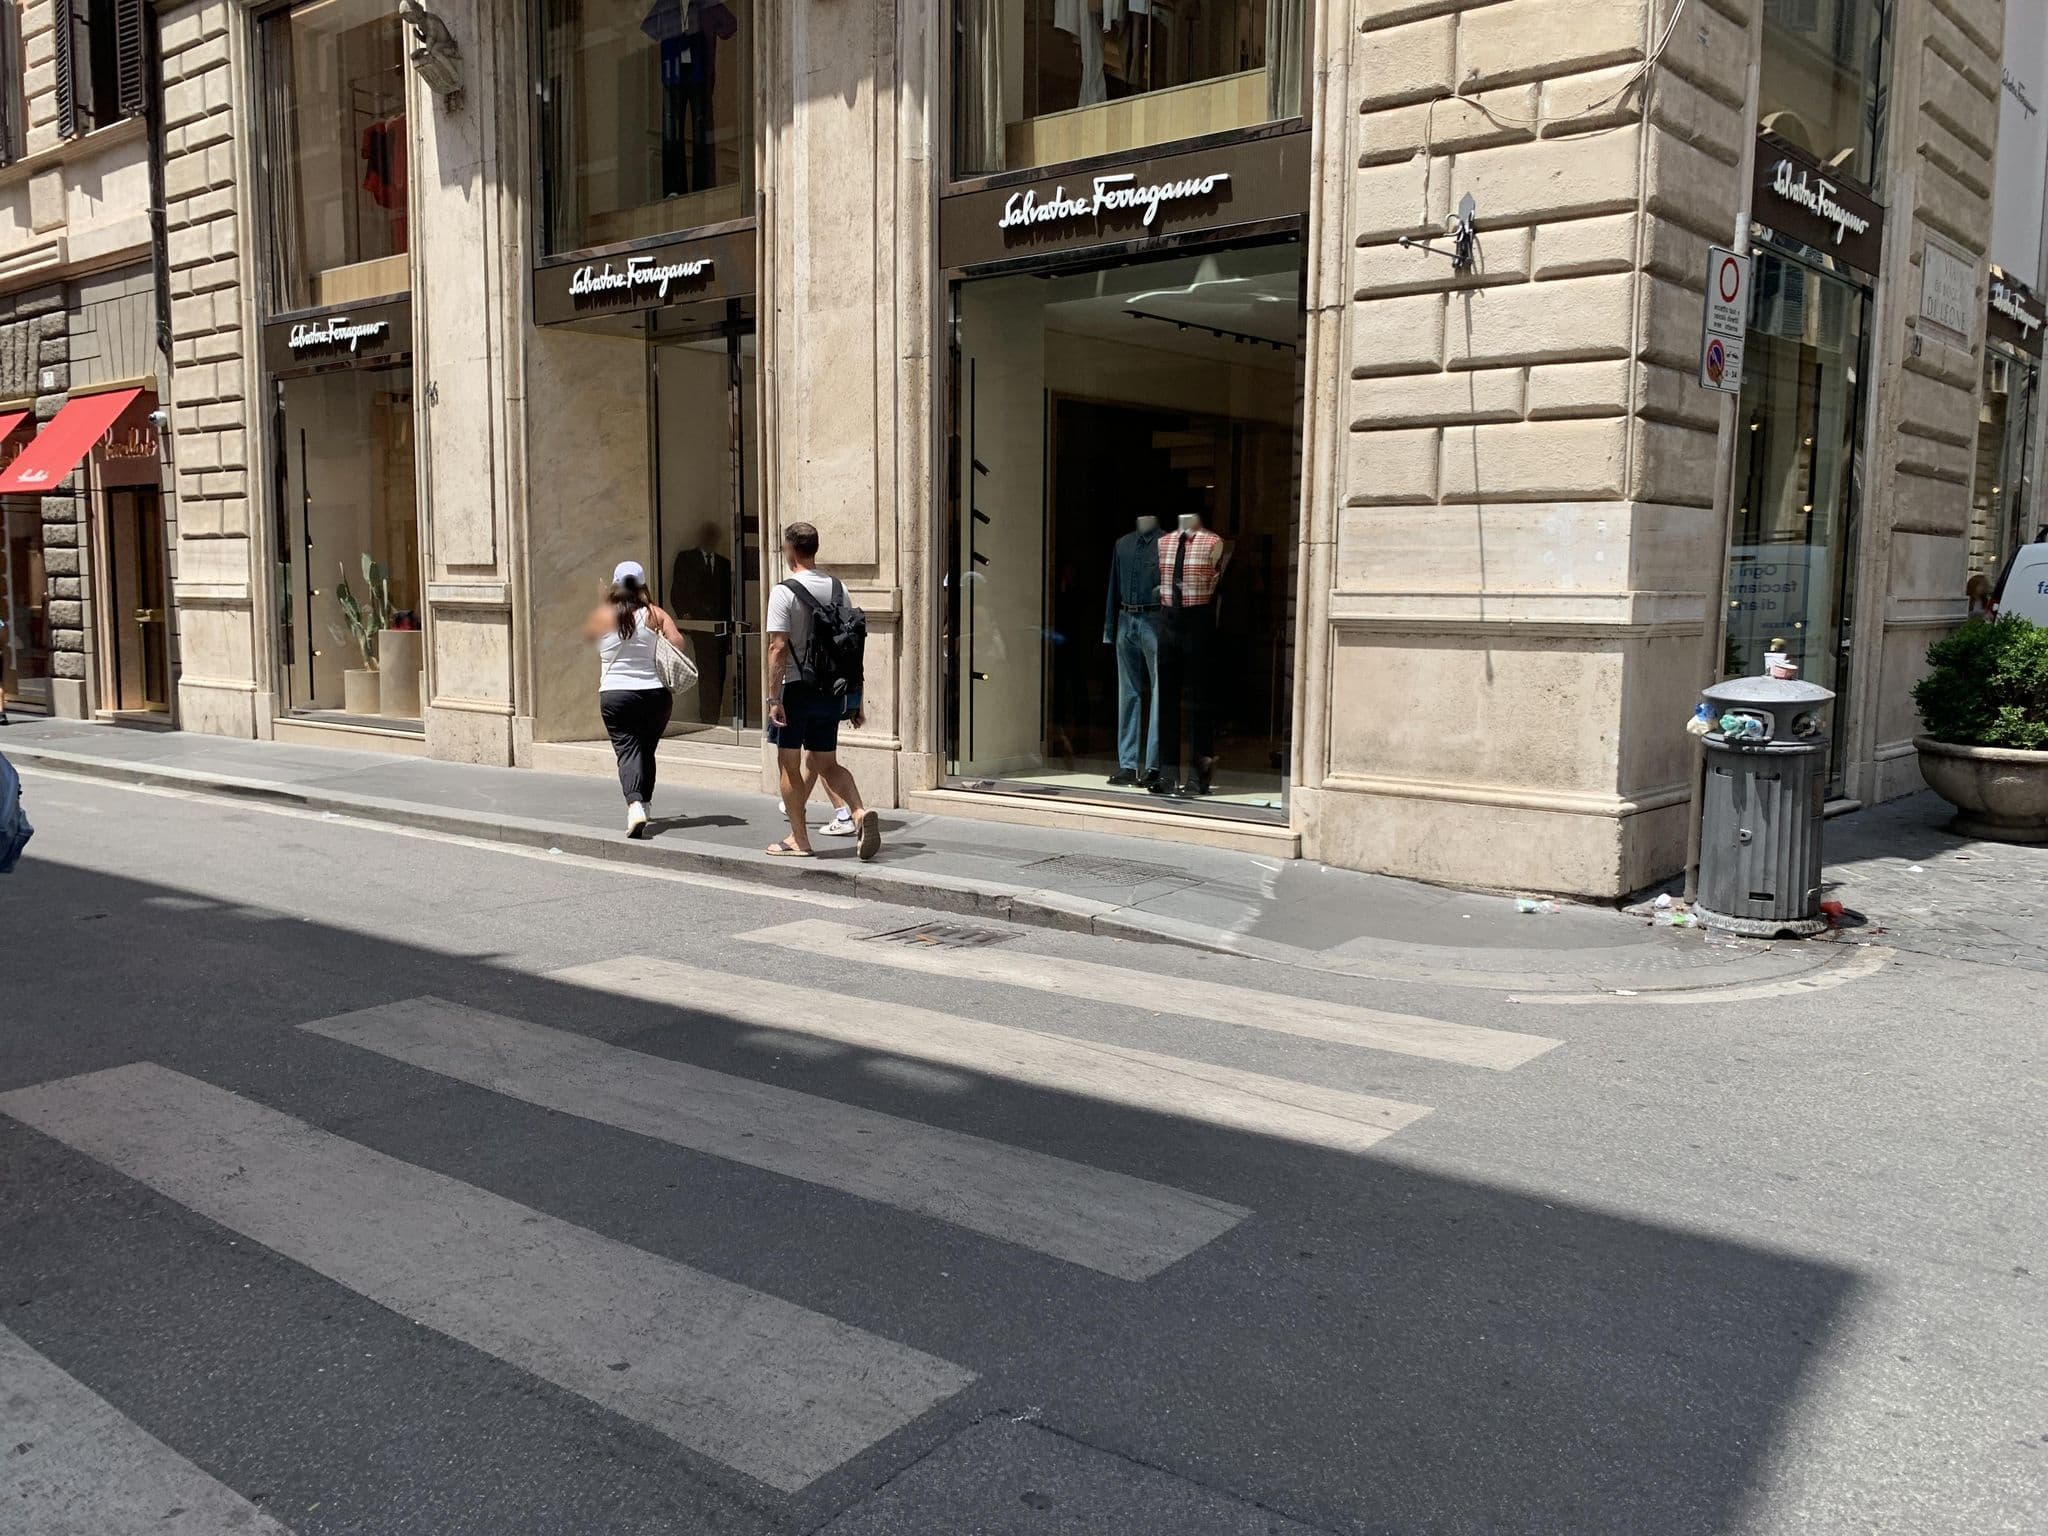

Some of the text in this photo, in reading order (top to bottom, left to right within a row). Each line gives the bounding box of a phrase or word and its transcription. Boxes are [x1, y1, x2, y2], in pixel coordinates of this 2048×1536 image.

[999, 173, 1232, 228] Salvatore Ferragamo
[1772, 159, 1870, 245] Salvatore Ferragamo
[569, 256, 714, 298] Salvatore Ferragamo
[288, 317, 389, 352] Salvatore Ferragamo
